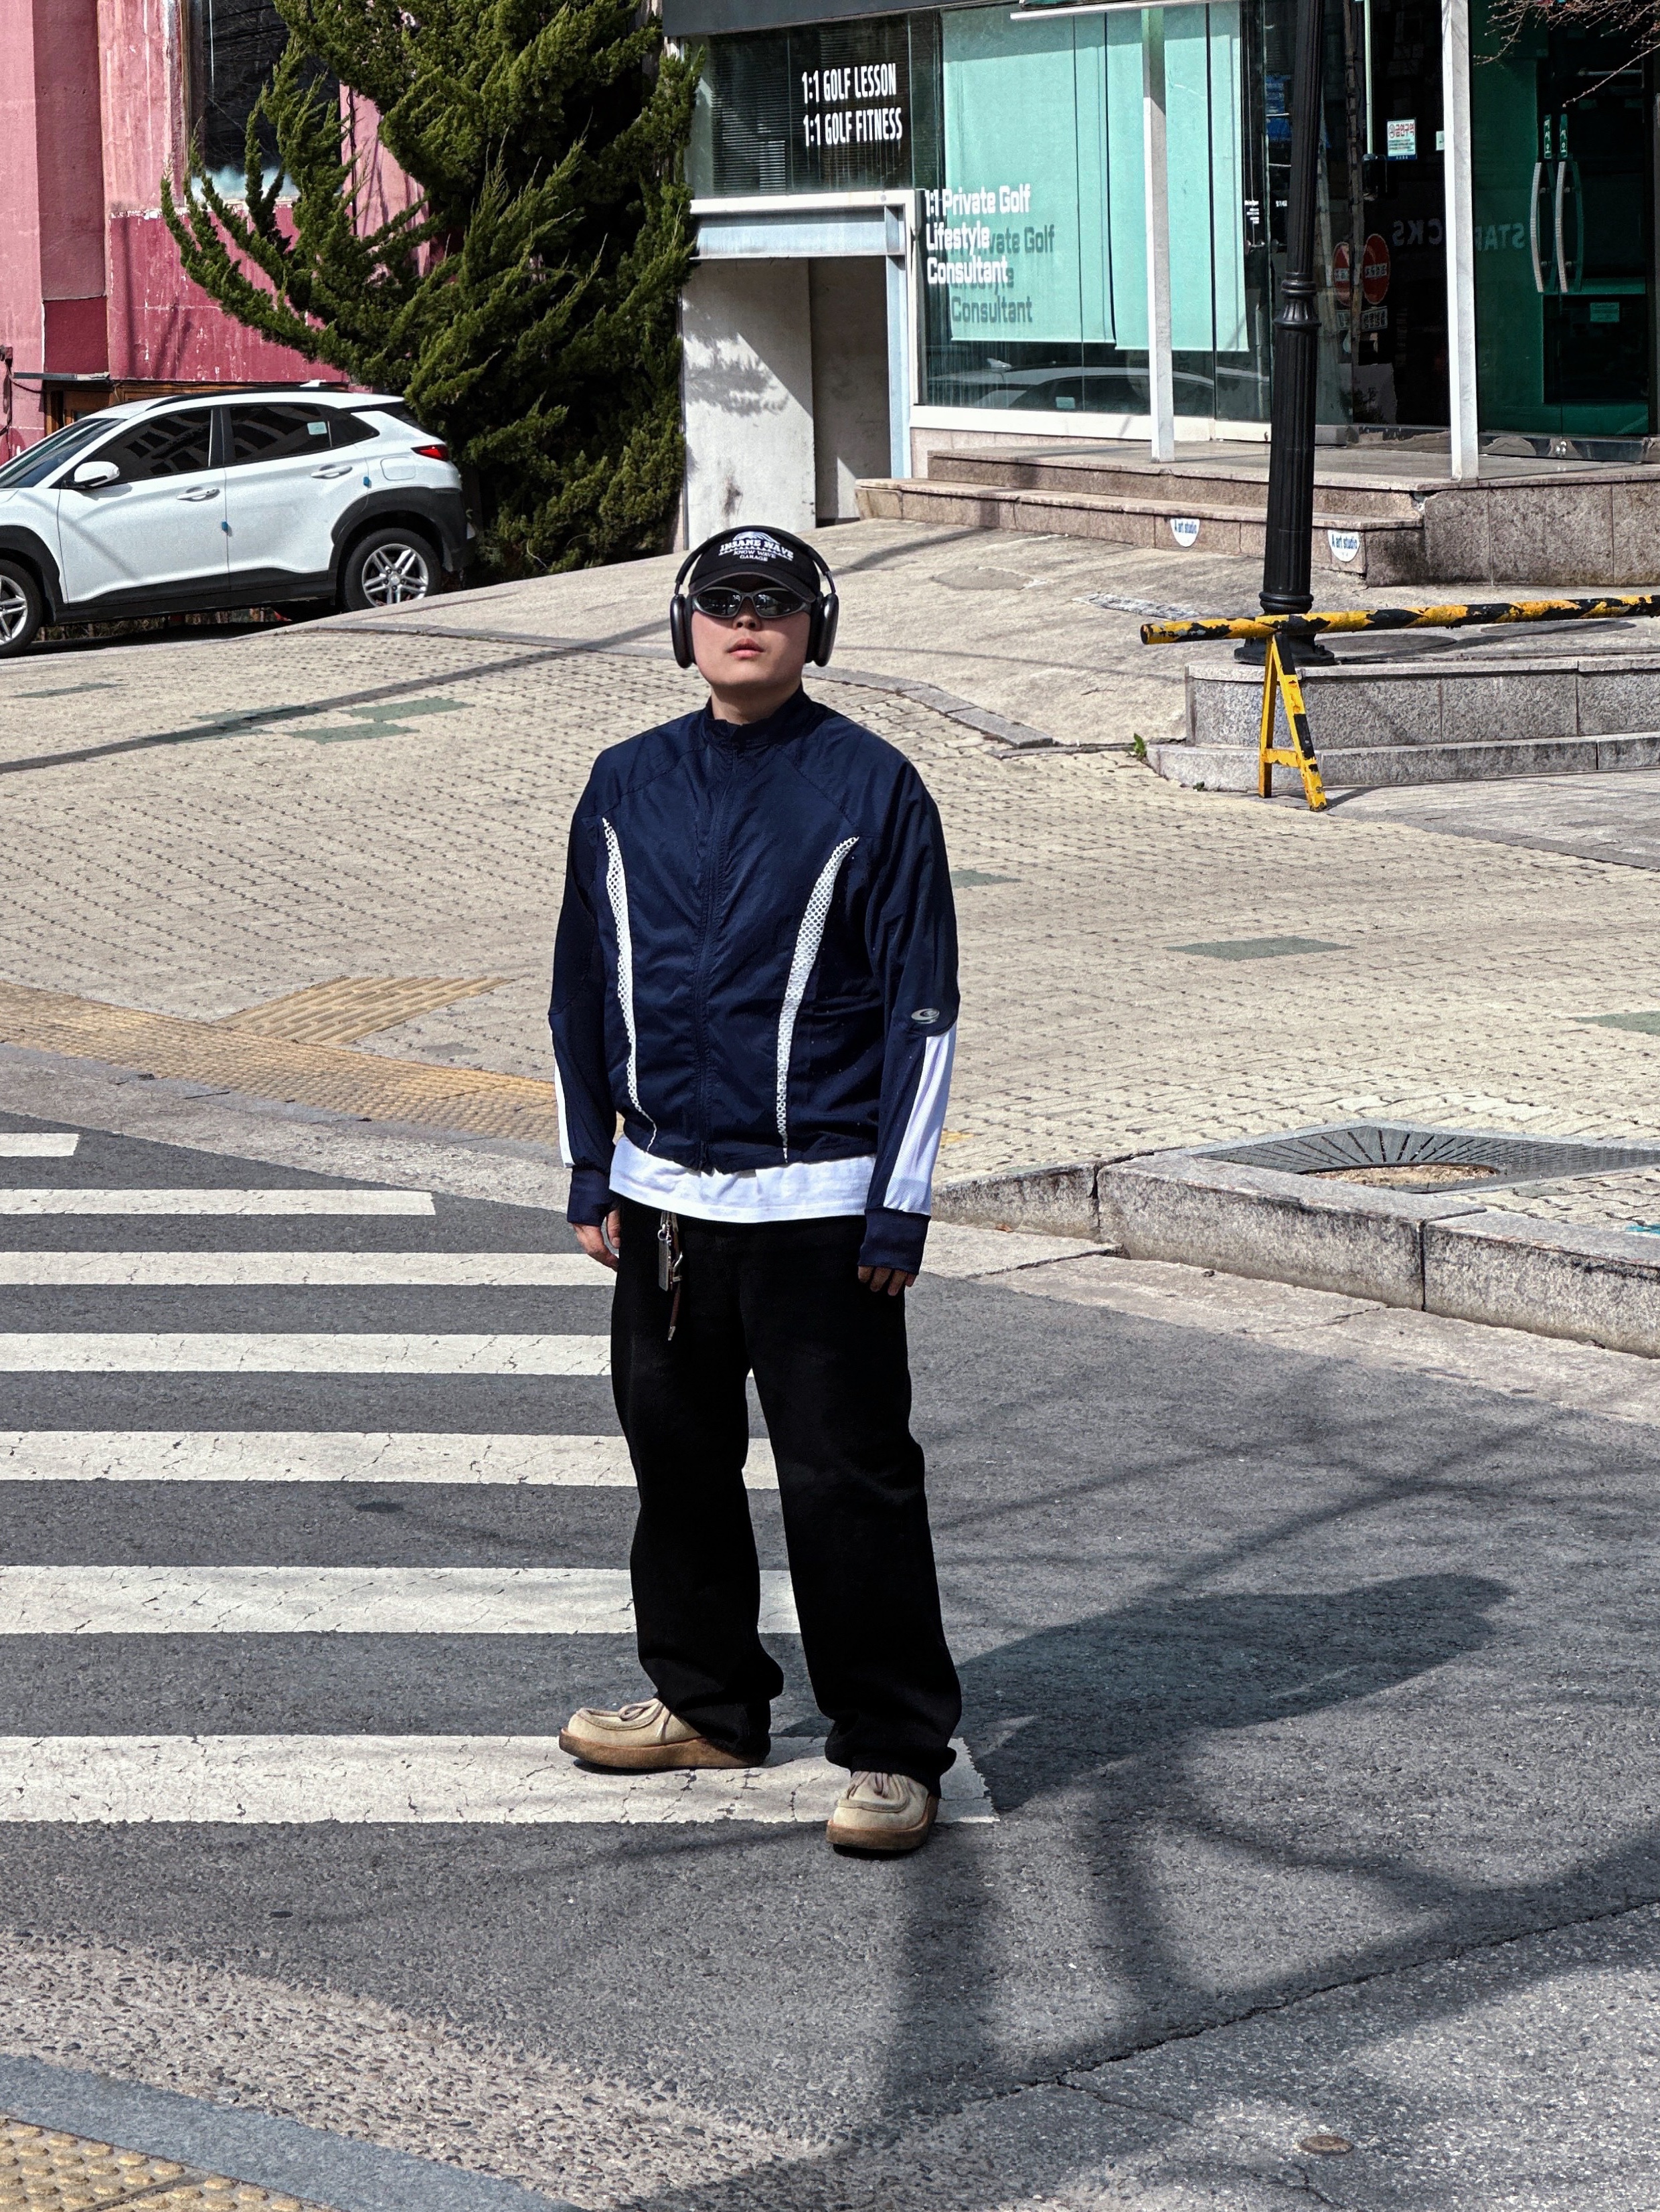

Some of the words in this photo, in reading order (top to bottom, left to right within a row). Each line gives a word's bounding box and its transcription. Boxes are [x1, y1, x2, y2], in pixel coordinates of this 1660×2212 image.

[802, 70, 820, 104] 1:1
[823, 68, 851, 102] GOLF
[854, 63, 896, 98] LESSON
[803, 113, 821, 147] 1:1
[825, 111, 852, 145] GOLF
[855, 107, 902, 143] FITNESS
[926, 189, 939, 217] 1:1
[942, 186, 996, 216] Private
[999, 183, 1031, 214] Golf
[926, 220, 990, 256] Lifestyle
[927, 254, 1008, 284] Consultant
[951, 294, 1032, 323] Consultant
[720, 539, 761, 553] INSANE
[764, 541, 794, 559] WAVE
[757, 550, 776, 559] WAVE
